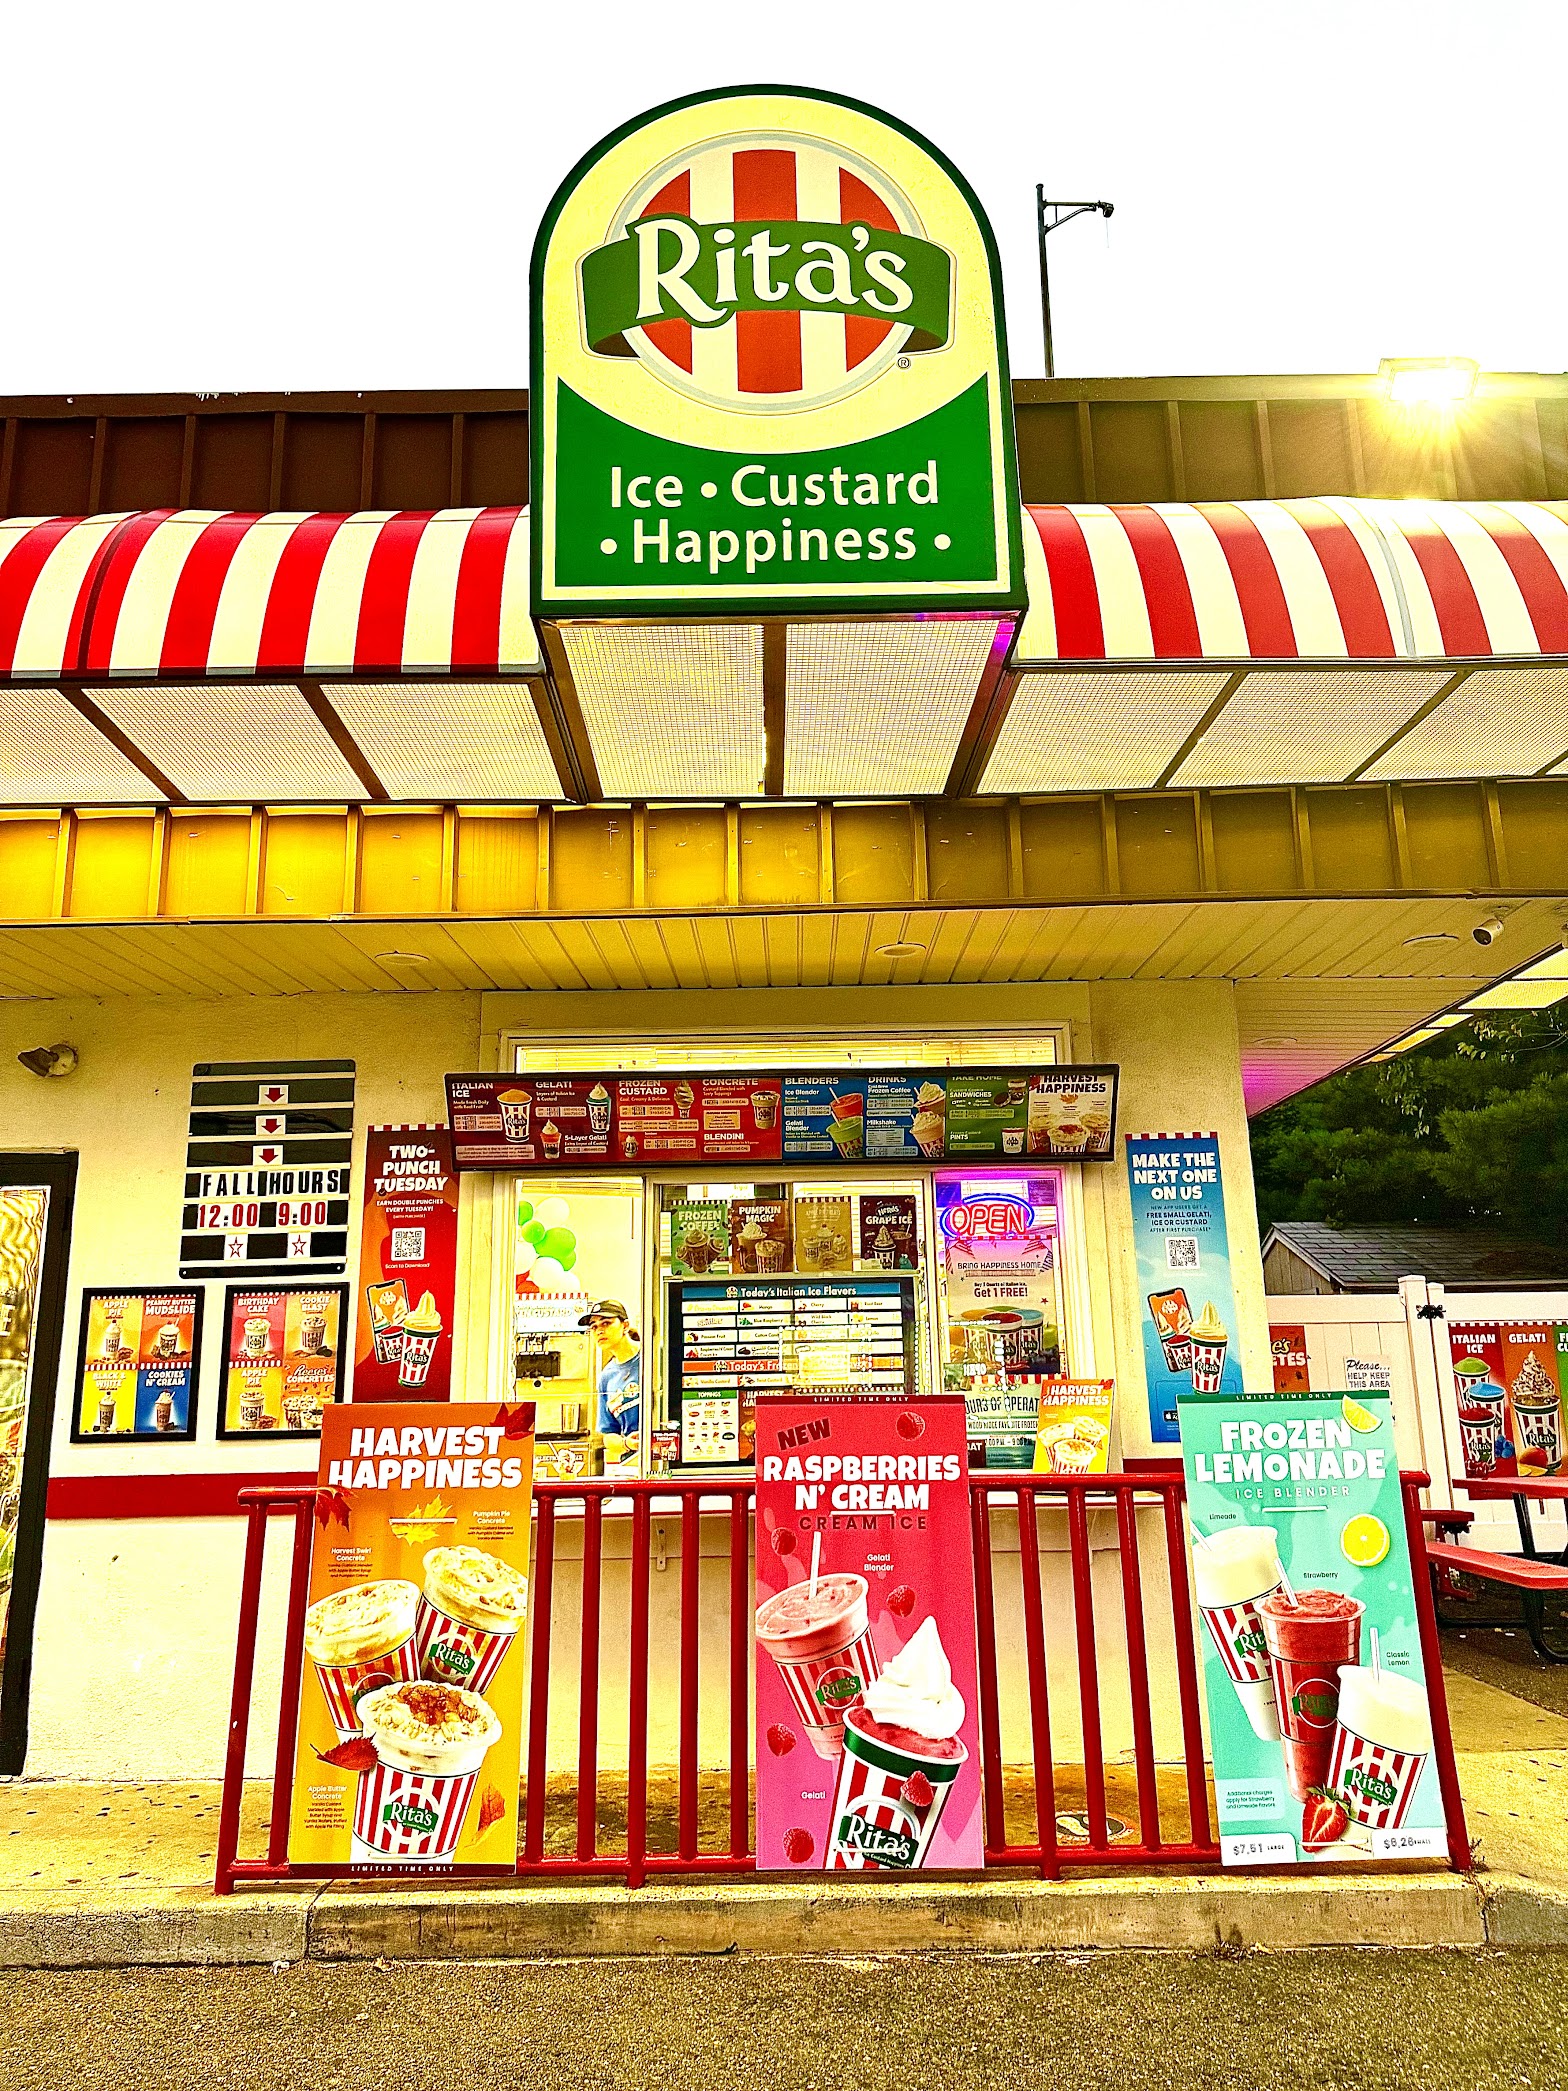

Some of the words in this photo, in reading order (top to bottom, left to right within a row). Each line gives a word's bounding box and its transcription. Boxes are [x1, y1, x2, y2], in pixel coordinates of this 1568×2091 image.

[634, 218, 915, 323] Rita's
[611, 466, 684, 508] Ice
[731, 460, 939, 507] Custard
[634, 517, 917, 574] Happiness
[702, 1078, 759, 1086] CONCRETE
[785, 1077, 839, 1085] BLENDERS
[1044, 1075, 1098, 1083] HARVEST
[452, 1082, 493, 1090] ITALIAN
[1037, 1083, 1105, 1093] HAPPINESS
[452, 1090, 470, 1098] ICE
[389, 1144, 435, 1159] TWO-
[1132, 1153, 1180, 1168] MAKE
[1183, 1152, 1215, 1166] THE
[382, 1160, 440, 1176] PUNCH
[1134, 1170, 1178, 1184] NEXT
[1182, 1169, 1217, 1183] ONE
[203, 1173, 255, 1196] FALL
[269, 1170, 339, 1195] HOURS
[373, 1177, 448, 1193] TUESDAY
[1151, 1186, 1177, 1200] ON
[1180, 1185, 1202, 1200] US
[199, 1203, 258, 1227] 12:00
[278, 1202, 326, 1226] 9:00
[678, 1210, 722, 1220] FROZEN
[739, 1206, 781, 1215] PUMPKIN
[746, 1214, 775, 1223] MAGIC
[866, 1216, 897, 1225] GRAPE
[899, 1216, 913, 1224] ICE
[950, 1203, 1026, 1236] OPEN
[680, 1221, 720, 1231] COFFEE
[741, 1287, 775, 1297] Today's
[776, 1287, 805, 1296] Italian
[808, 1287, 822, 1296] Ice
[823, 1286, 856, 1295] Flavors
[974, 1288, 990, 1297] Get
[993, 1288, 998, 1297] 1
[1000, 1287, 1028, 1297] FREE!
[103, 1301, 129, 1309] APPLE
[238, 1298, 279, 1306] BIRTHDAY
[300, 1296, 331, 1304] COOKIE
[145, 1305, 195, 1315] MUDSLIDE
[247, 1305, 269, 1313] CAKE
[1452, 1334, 1496, 1344] ITALIAN
[1508, 1333, 1547, 1343] GELATI
[1467, 1344, 1484, 1354] ICE
[730, 1361, 765, 1372] Today's
[148, 1370, 184, 1378] COOKIES
[241, 1369, 268, 1377] APPLE
[156, 1378, 185, 1386] CREAM
[287, 1375, 335, 1383] CONCRETES
[1370, 1380, 1391, 1388] AREA
[1051, 1385, 1104, 1396] HARVEST
[965, 1398, 988, 1414] OURS
[1044, 1396, 1109, 1406] HAPPINESS
[777, 1417, 832, 1451] NEW
[1221, 1419, 1351, 1452] FROZEN
[1529, 1432, 1555, 1445] Rita's
[350, 1426, 506, 1458] HARVEST
[763, 1454, 961, 1482] RASPBERRIES
[1194, 1449, 1386, 1483] LEMONADE
[328, 1457, 523, 1490] HAPPINESS
[795, 1484, 826, 1511] N'
[831, 1483, 930, 1511] CREAM
[1236, 1488, 1264, 1499] ICE
[1274, 1486, 1351, 1498] BLENDER
[473, 1510, 500, 1518] Pumpkin
[799, 1516, 878, 1530] CREAM
[890, 1516, 927, 1530] ICE
[867, 1553, 891, 1562] Gelati
[864, 1563, 895, 1572] Blender
[436, 1642, 469, 1669] Rita's
[821, 1676, 858, 1699] Rita's
[1351, 1768, 1392, 1799] Rita's
[308, 1785, 327, 1793] Apple
[801, 1791, 826, 1799] Gelati
[390, 1801, 433, 1827] Rita's
[846, 1813, 912, 1860] Rita's
